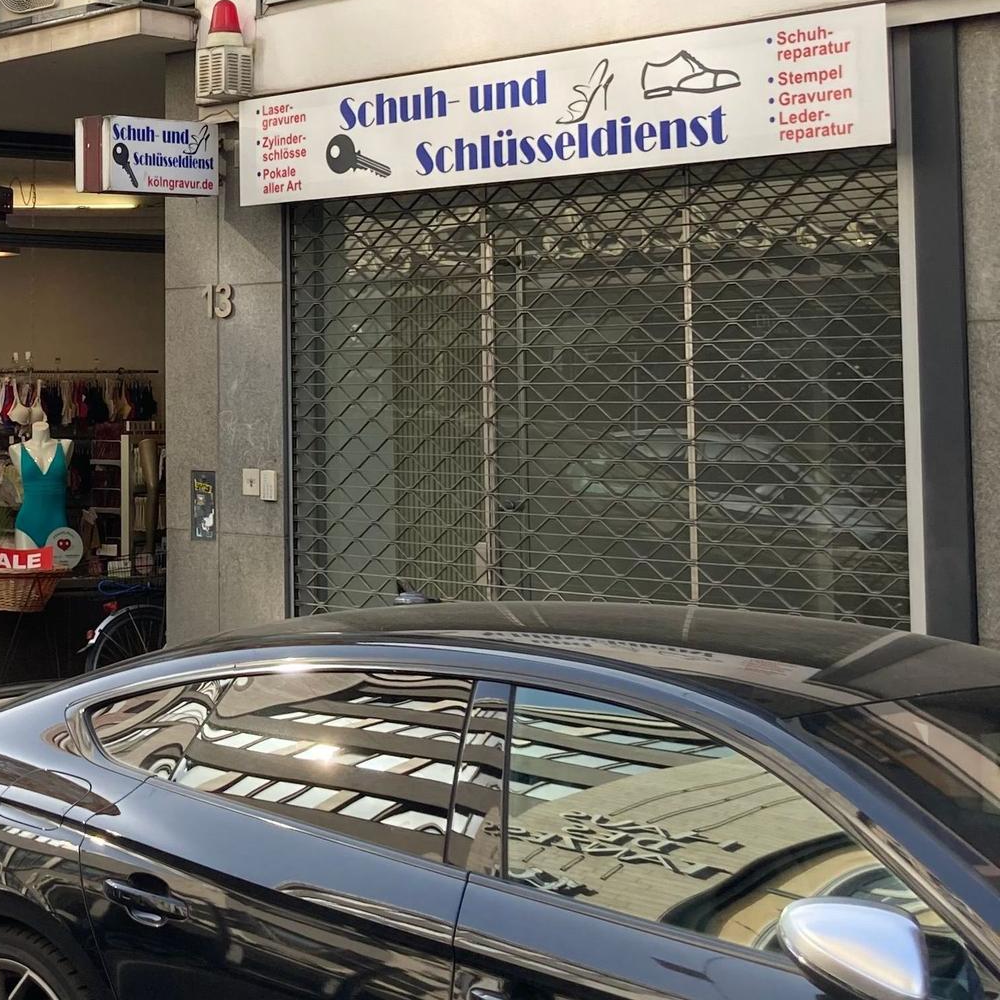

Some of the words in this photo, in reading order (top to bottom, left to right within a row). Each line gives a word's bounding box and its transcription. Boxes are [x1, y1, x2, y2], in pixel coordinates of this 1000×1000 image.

[776, 26, 833, 45] Schuh-
[777, 41, 851, 62] reparatur
[778, 64, 842, 86] Stempel
[339, 85, 460, 131] Schuh-
[469, 69, 548, 114] und
[778, 87, 852, 106] Gravuren
[262, 104, 293, 116] Laser-
[779, 109, 830, 126] Leder-
[262, 113, 306, 130] gravuren
[112, 123, 159, 142] Schuh-
[162, 129, 189, 145] und
[415, 105, 729, 177] Schlüsseldienst
[779, 122, 853, 143] reparatur
[262, 133, 306, 151] Zylinder-
[133, 152, 214, 170] Schlüsseldienst
[262, 147, 307, 161] schlösse
[263, 166, 296, 180] Pokale
[147, 175, 214, 190] kölngravur.de
[263, 182, 284, 194] aller
[287, 180, 302, 192] Art
[201, 282, 234, 319] 13
